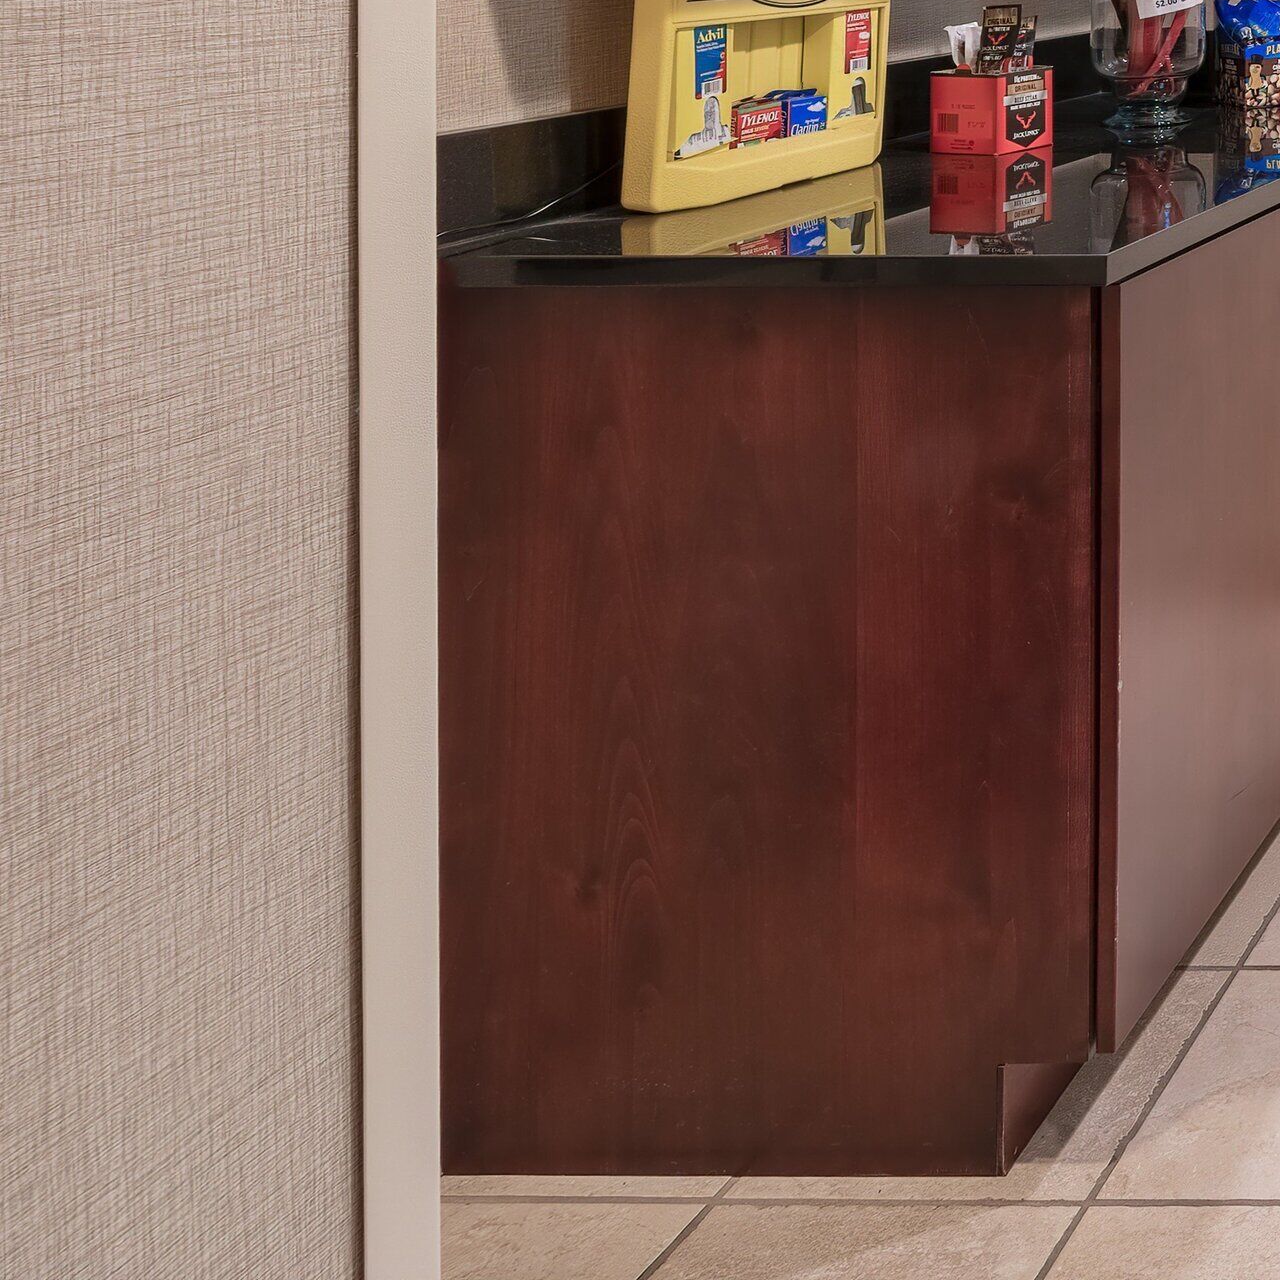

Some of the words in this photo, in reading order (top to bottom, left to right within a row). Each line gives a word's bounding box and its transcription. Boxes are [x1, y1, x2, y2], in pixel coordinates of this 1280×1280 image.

[847, 12, 870, 22] TYLENOL
[696, 28, 724, 44] Advil
[1014, 84, 1037, 93] ORIGINAL
[740, 110, 781, 130] TYLENOL
